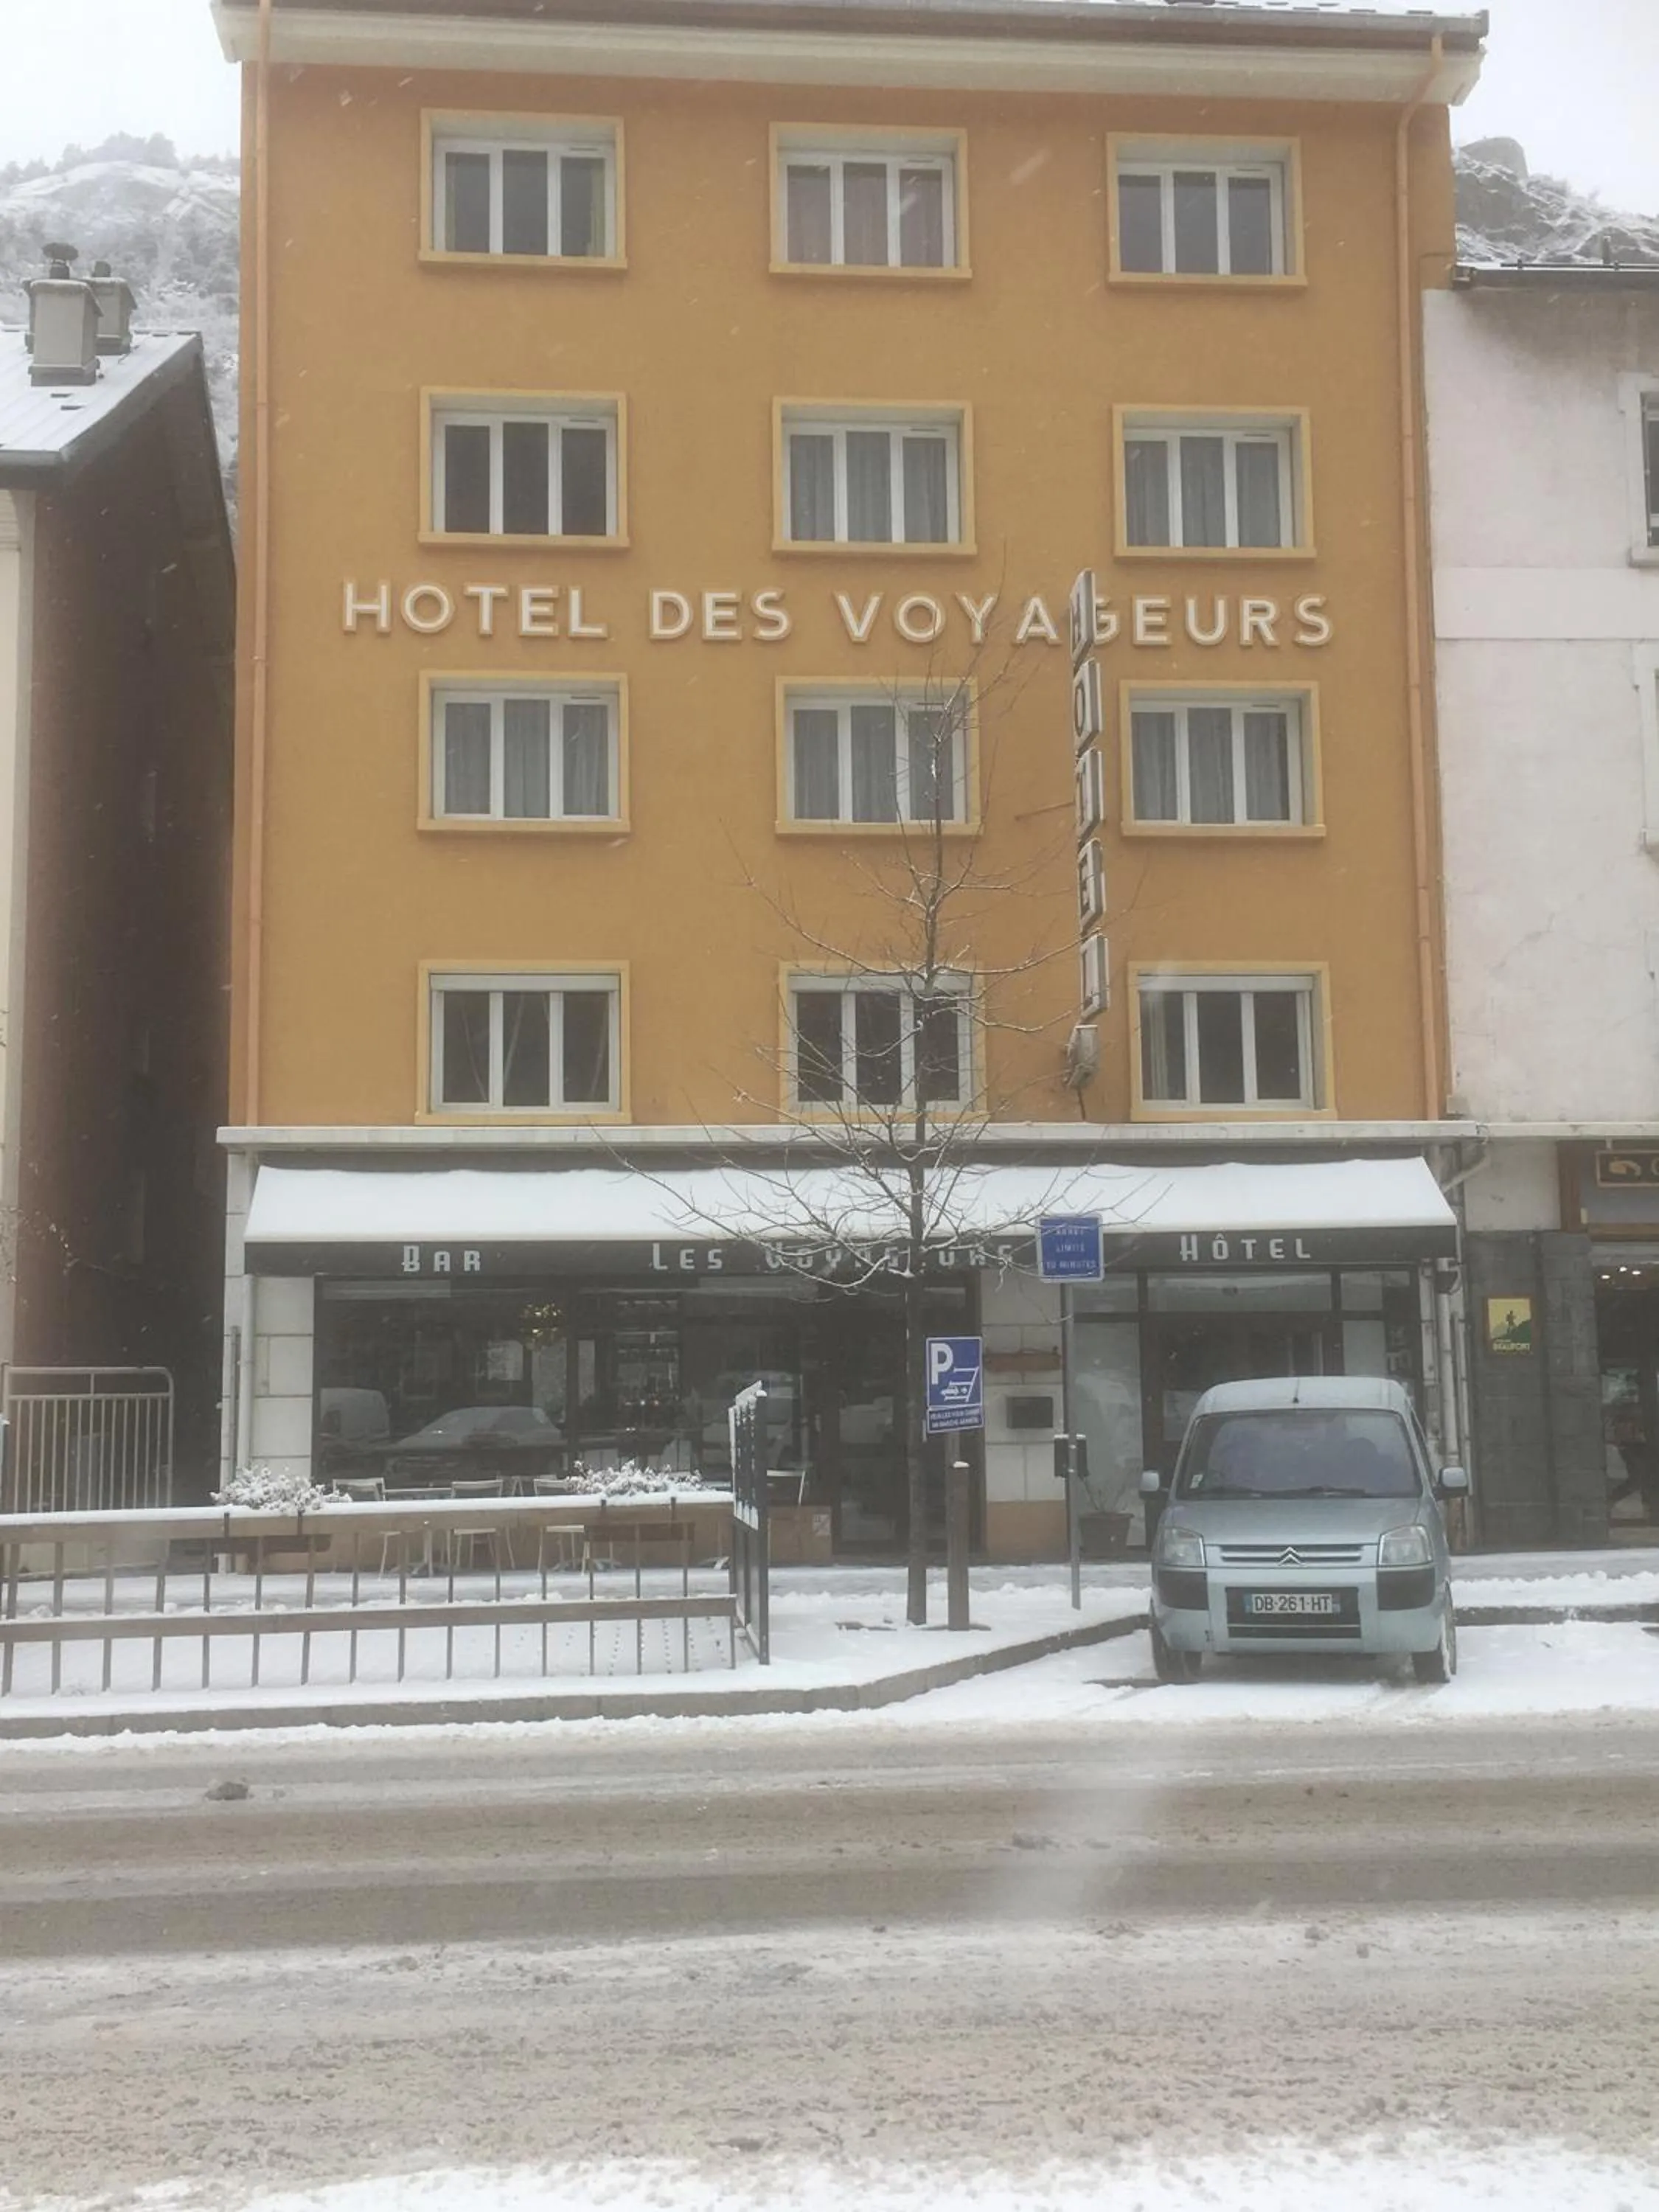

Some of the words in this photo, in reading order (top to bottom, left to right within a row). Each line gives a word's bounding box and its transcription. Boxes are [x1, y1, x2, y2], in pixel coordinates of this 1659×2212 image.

[342, 578, 608, 639] HOTEL
[649, 588, 793, 641] DES
[834, 591, 1334, 647] VOYAGEURS
[403, 1245, 481, 1272] BAR
[652, 1242, 723, 1270] LES
[1180, 1233, 1312, 1262] HÔTEL
[931, 1342, 954, 1385] P
[1254, 1595, 1330, 1613] DB-261-HT
